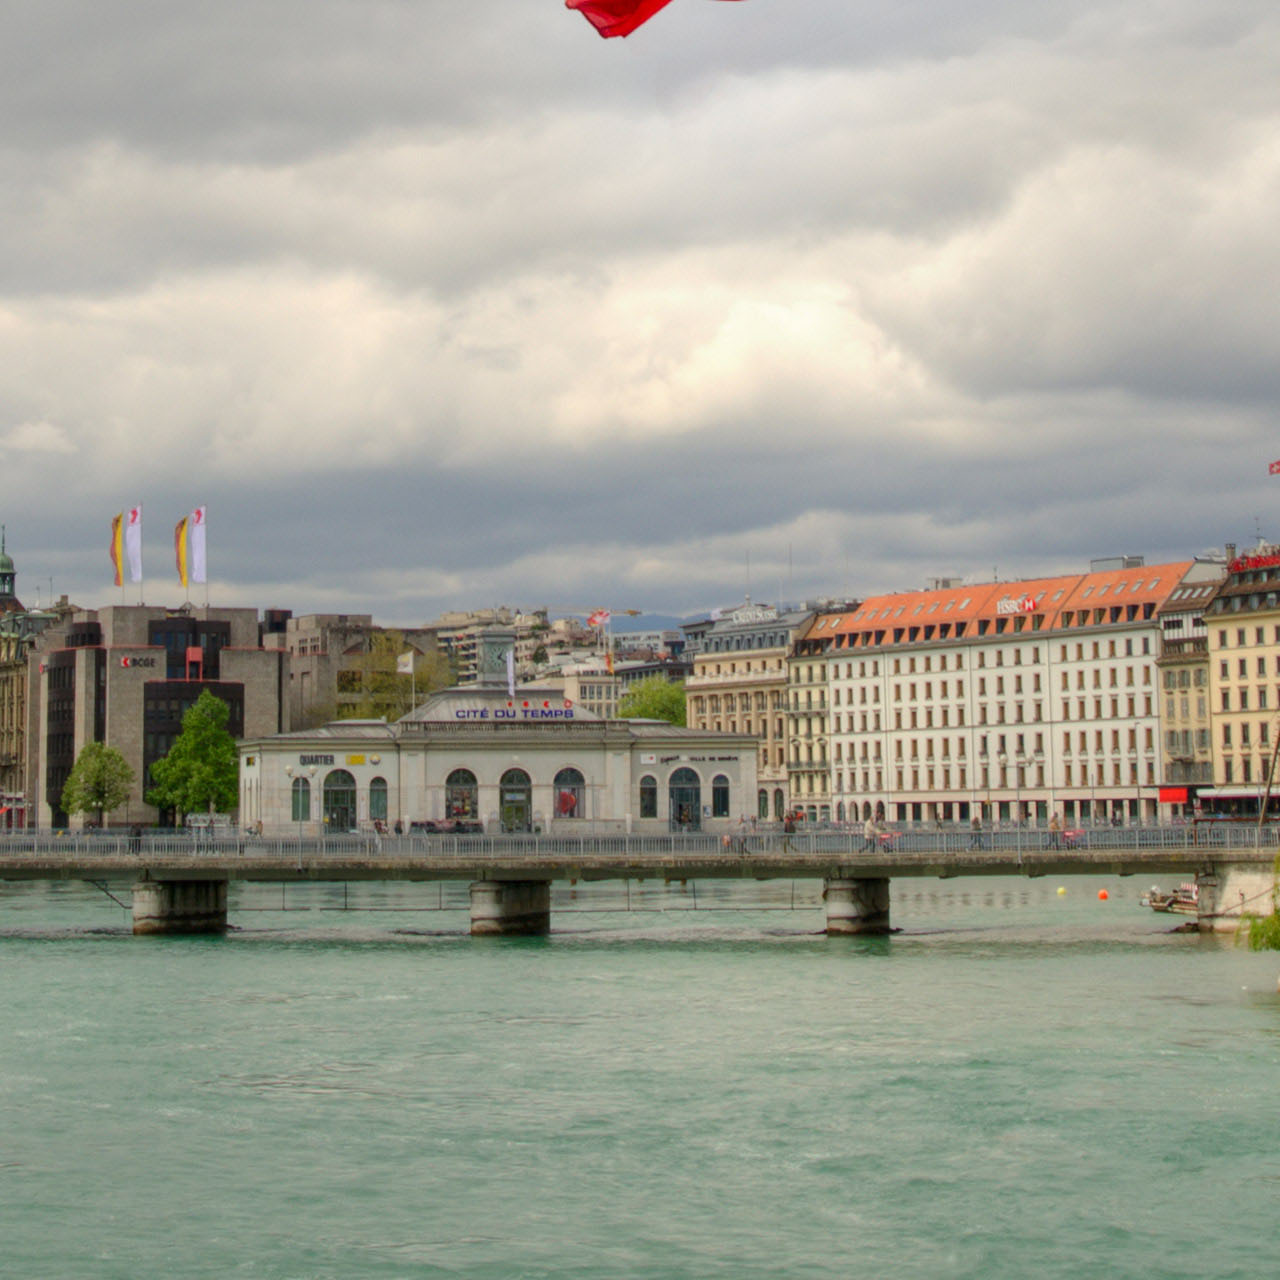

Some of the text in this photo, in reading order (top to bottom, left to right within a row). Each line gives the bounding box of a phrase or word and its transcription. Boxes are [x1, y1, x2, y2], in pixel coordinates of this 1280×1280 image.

[997, 599, 1020, 614] HSBC
[455, 707, 574, 719] CITÉ DU TEMPS
[299, 754, 335, 766] QUARTIER
